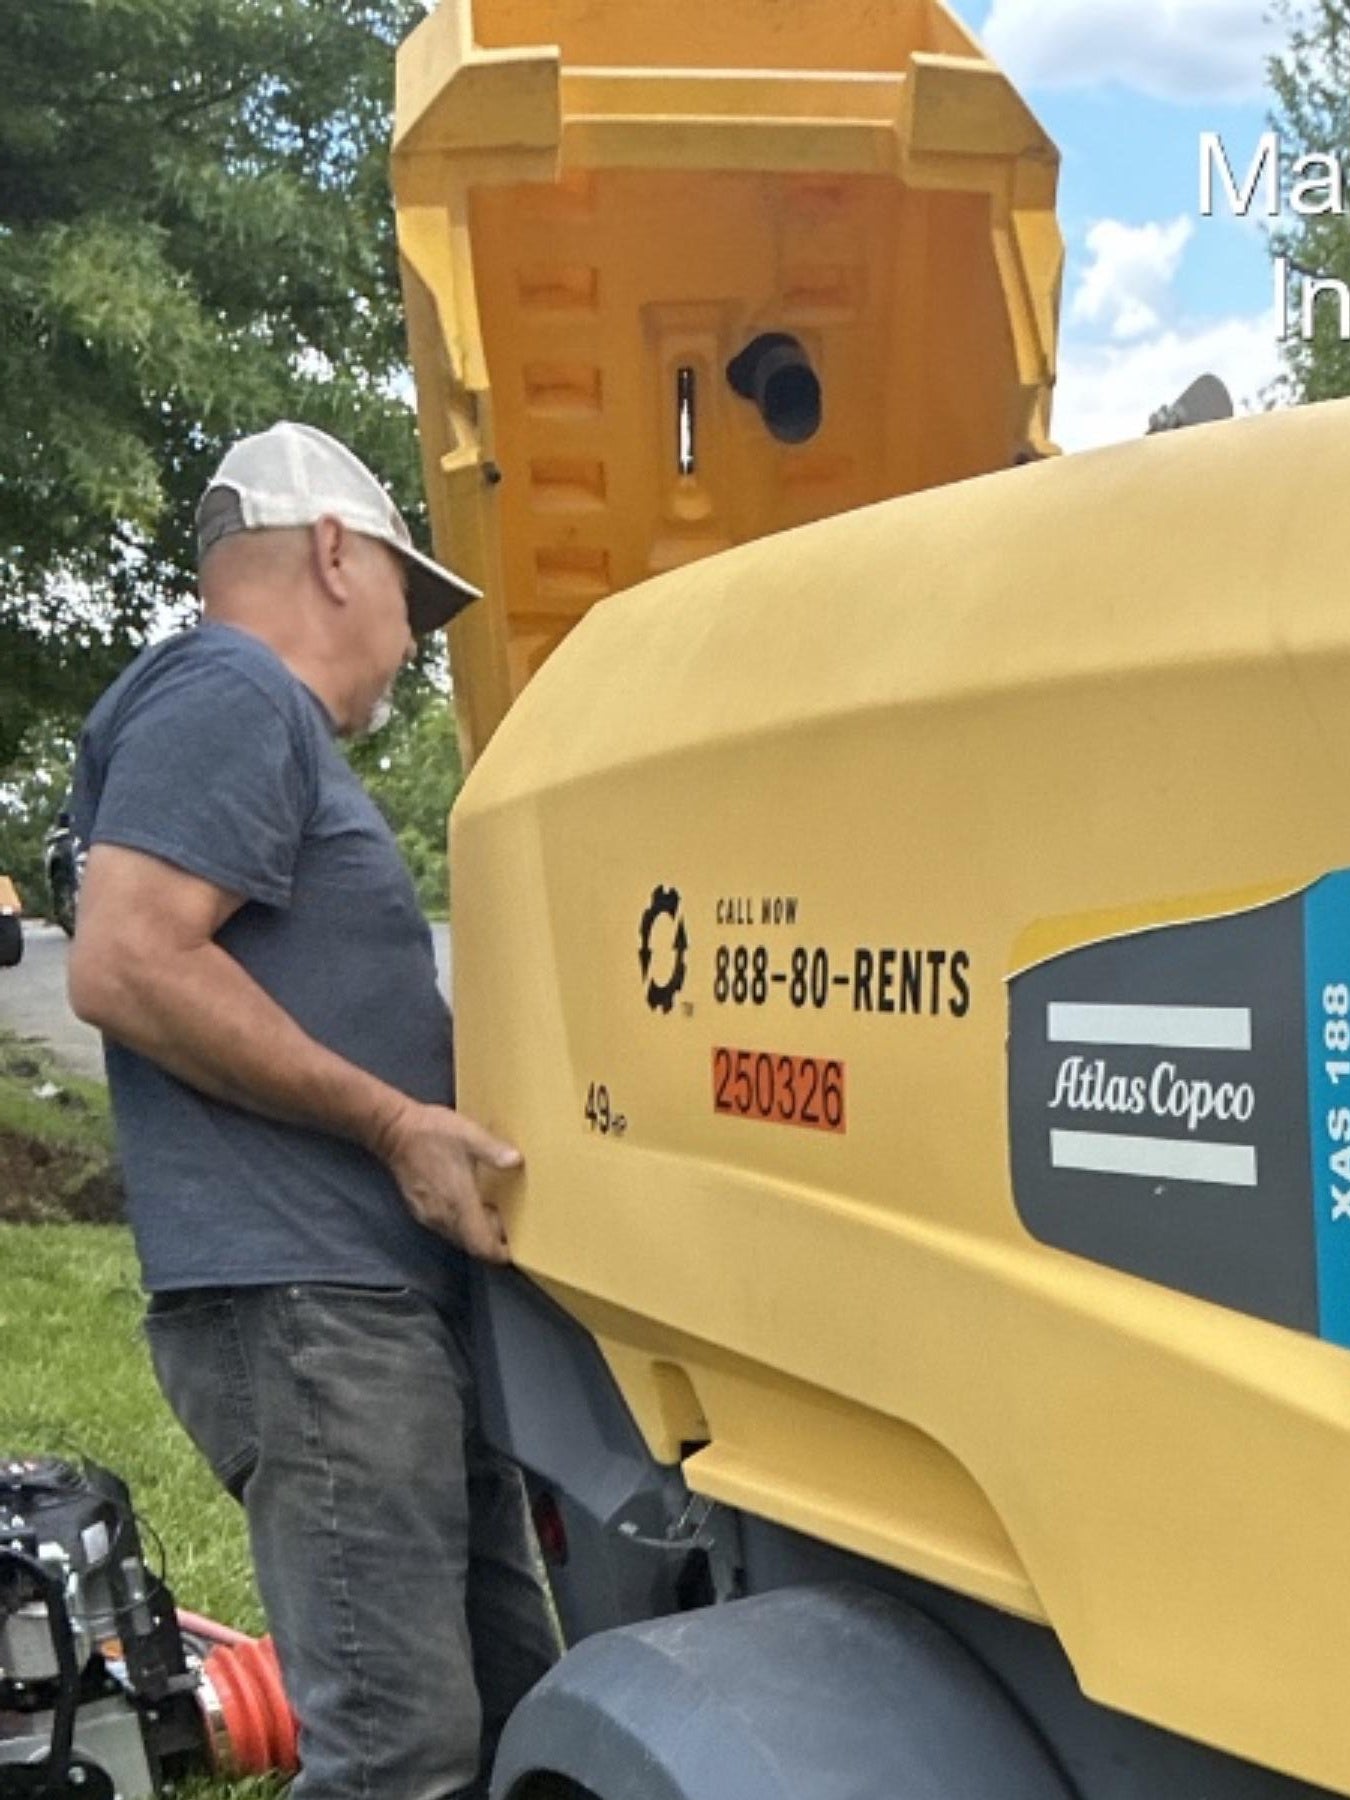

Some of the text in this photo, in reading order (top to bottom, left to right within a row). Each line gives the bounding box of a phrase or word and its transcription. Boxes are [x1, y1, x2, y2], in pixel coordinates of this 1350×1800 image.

[716, 896, 798, 925] CALL NOW
[713, 943, 972, 1018] 888-80-RENTS
[713, 1047, 844, 1129] 250326
[1048, 1055, 1256, 1132] Atlas Copco
